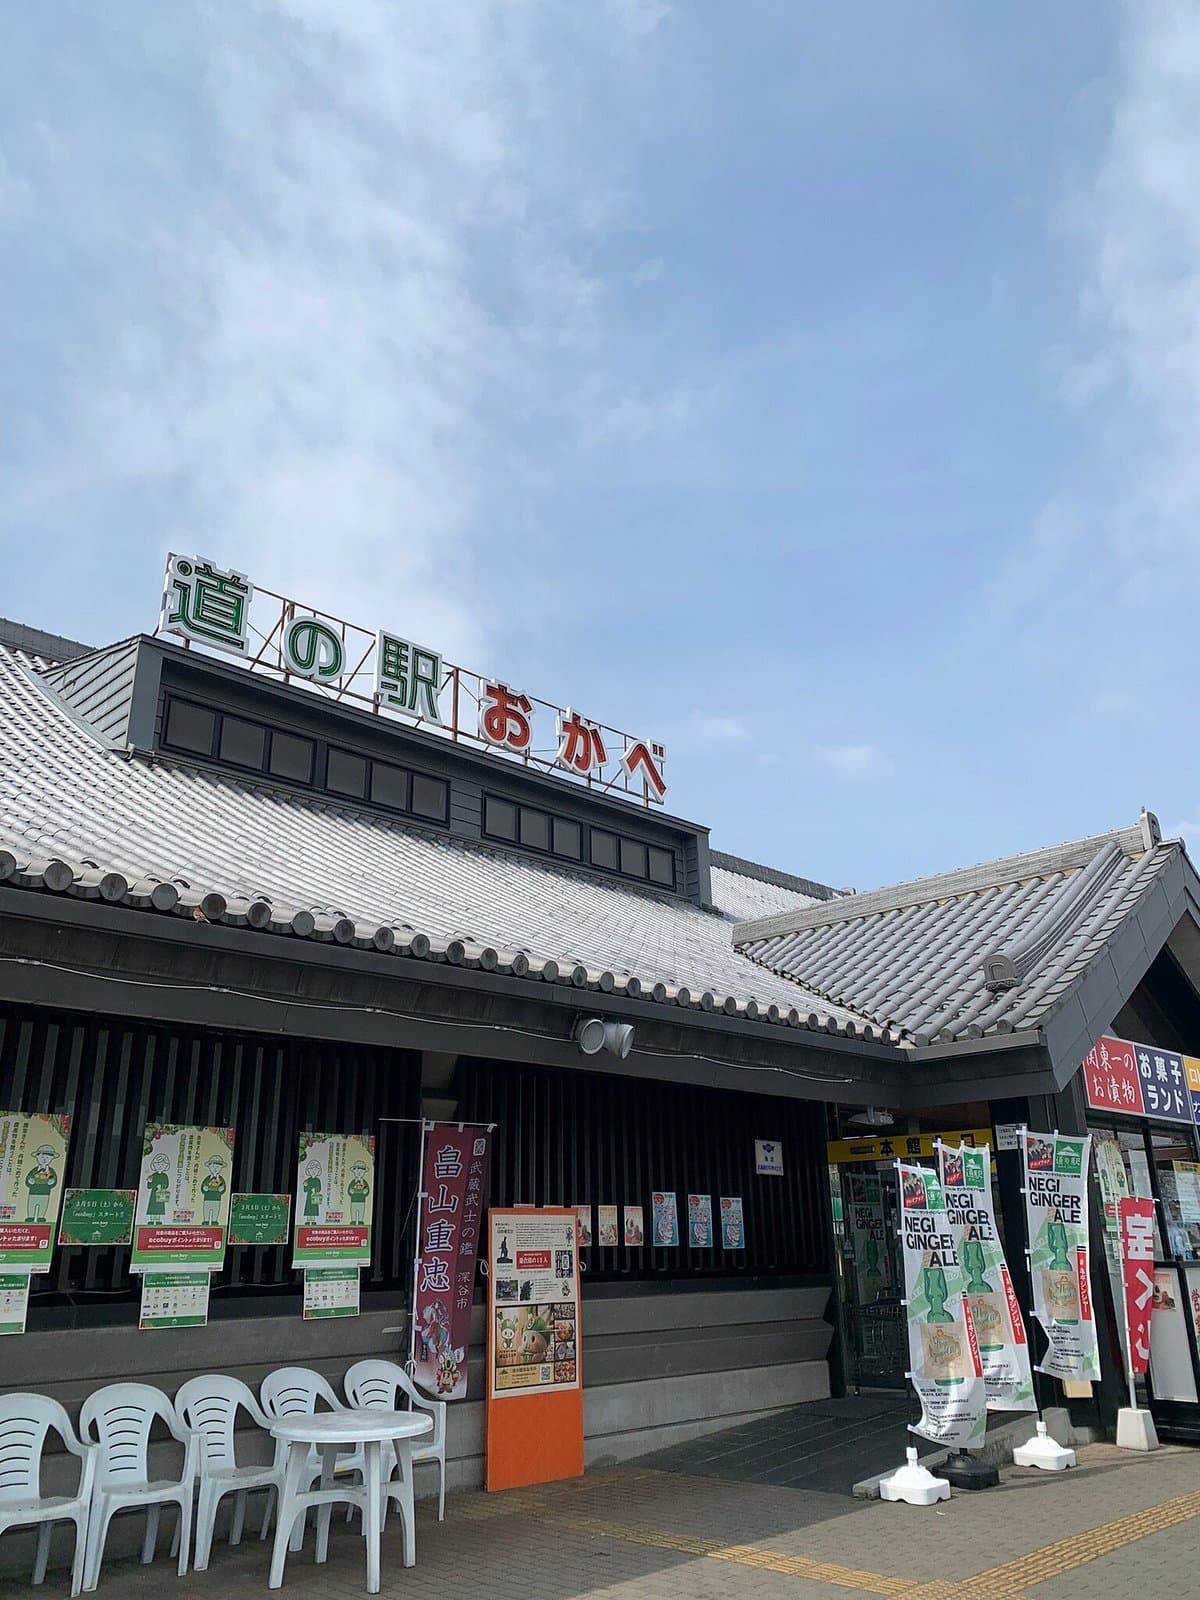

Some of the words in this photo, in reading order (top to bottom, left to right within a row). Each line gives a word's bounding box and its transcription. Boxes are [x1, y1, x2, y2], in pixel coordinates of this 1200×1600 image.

[161, 553, 442, 726] 道の駅
[481, 681, 667, 801] おかべ
[1139, 1052, 1182, 1085] お菓子
[1093, 1074, 1135, 1104] お漬物
[1147, 1084, 1184, 1114] ランド
[1029, 1177, 1060, 1192] NEGI
[458, 1160, 484, 1256] 武蔵武士の鑑
[855, 1207, 873, 1219] NEGI
[946, 1193, 974, 1208] NEGI
[1030, 1192, 1081, 1209] GINGER
[420, 1144, 462, 1293] 畠山重忠
[905, 1216, 935, 1233] NEGI
[1054, 1209, 1081, 1224] ALE
[456, 1271, 471, 1310] 深谷市
